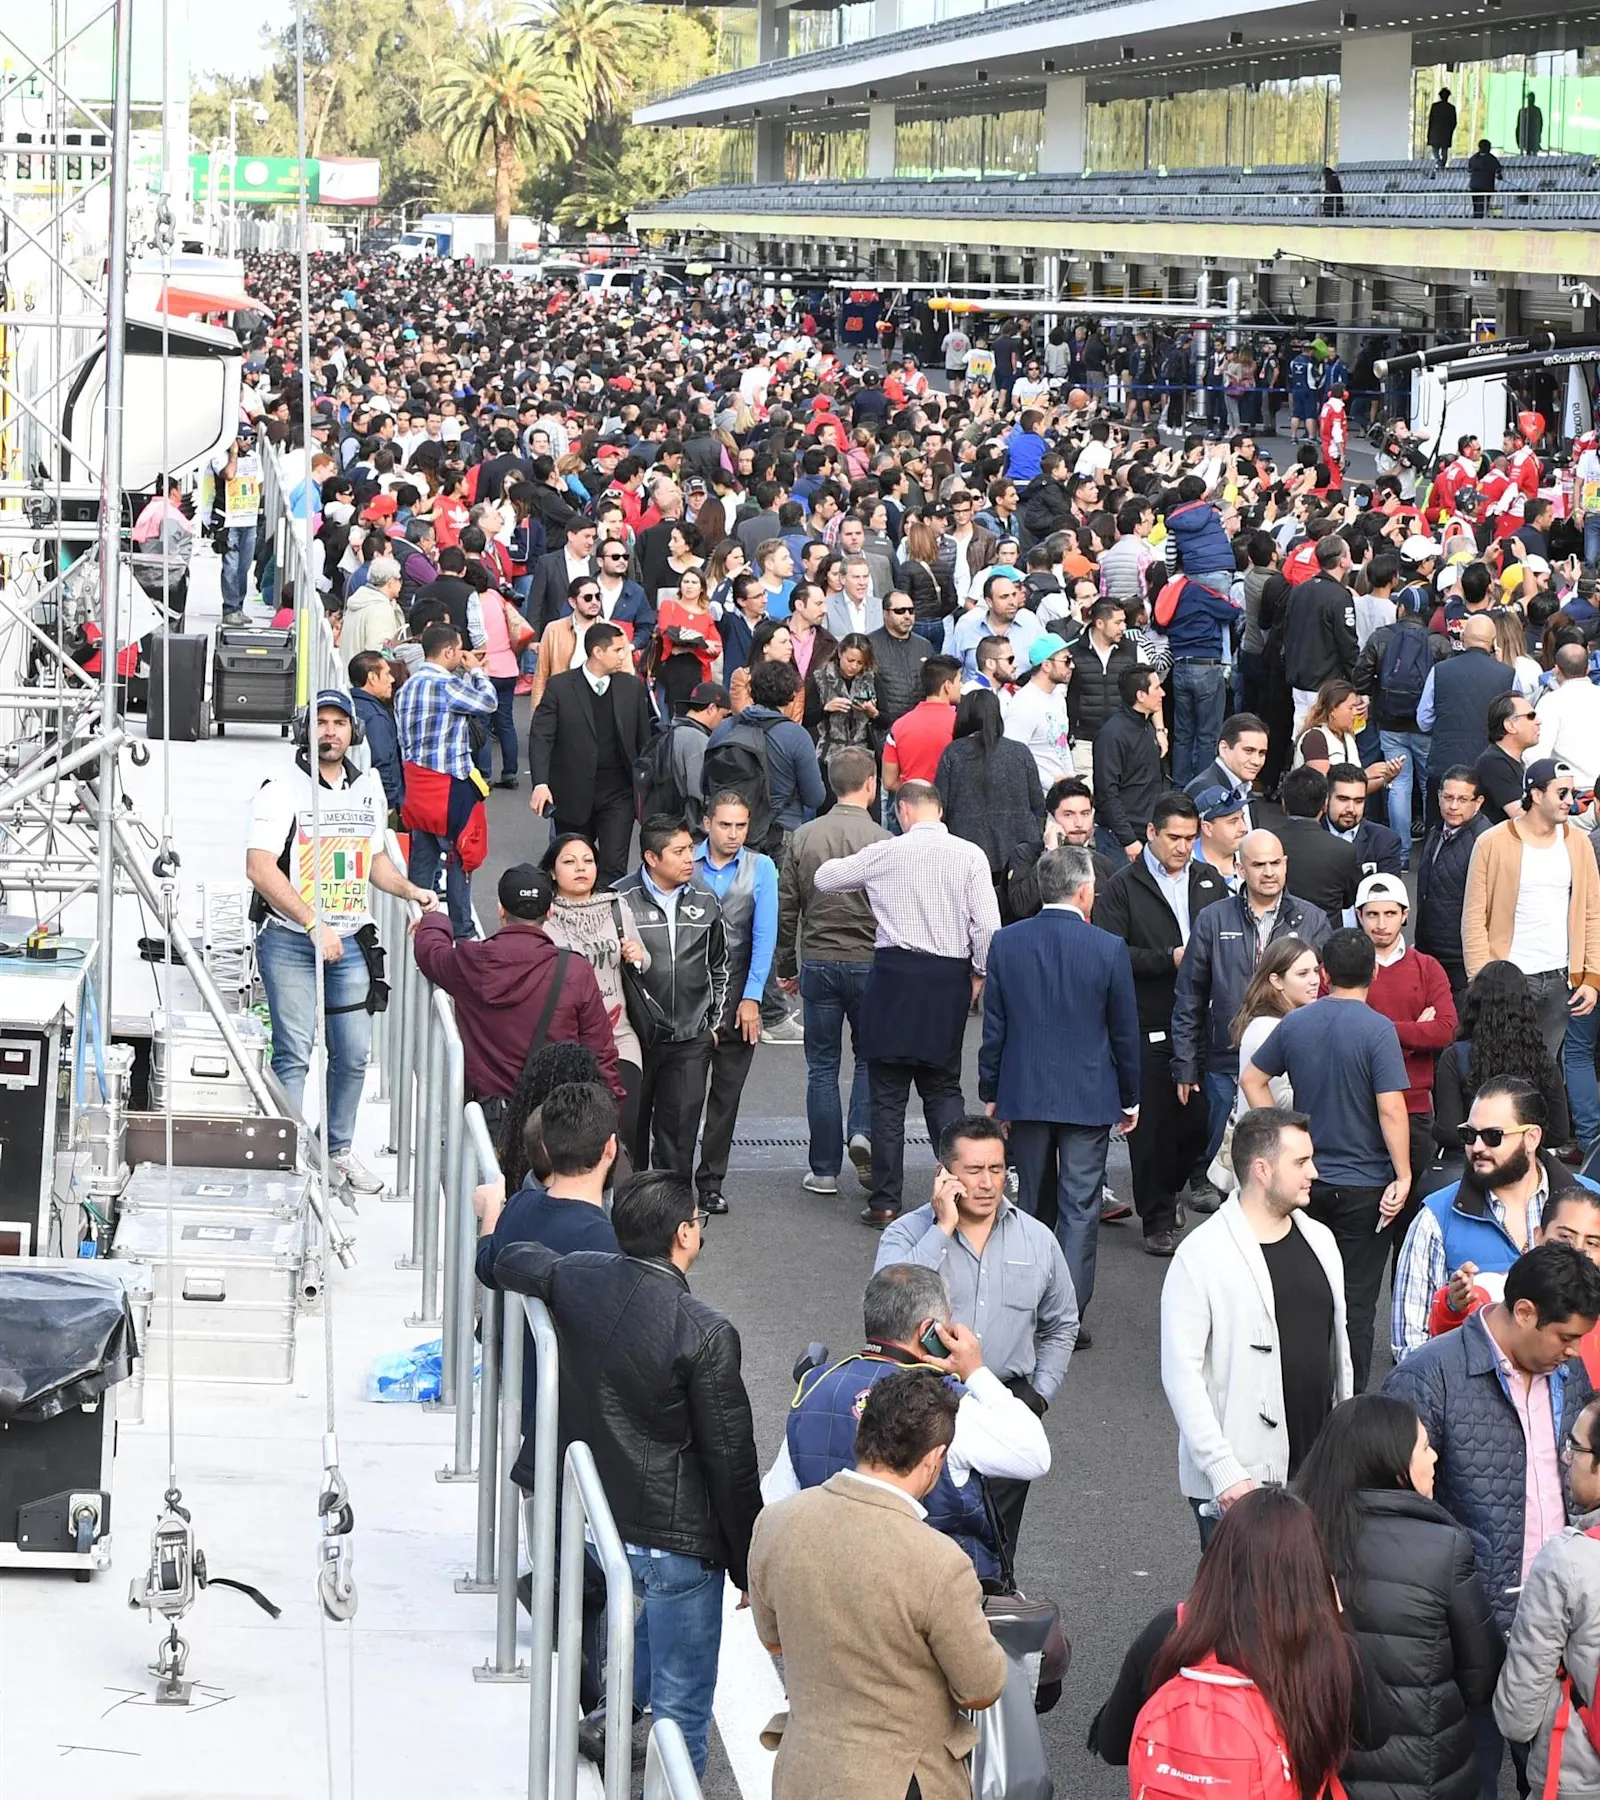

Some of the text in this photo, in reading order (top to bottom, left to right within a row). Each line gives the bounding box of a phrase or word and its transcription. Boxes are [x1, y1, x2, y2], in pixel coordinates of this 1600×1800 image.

[1260, 259, 1273, 268] 14
[1473, 271, 1487, 281] 11
[1561, 276, 1577, 286] 10
[1468, 341, 1530, 357] @ScuderiaFerrari
[321, 883, 341, 894] PIT
